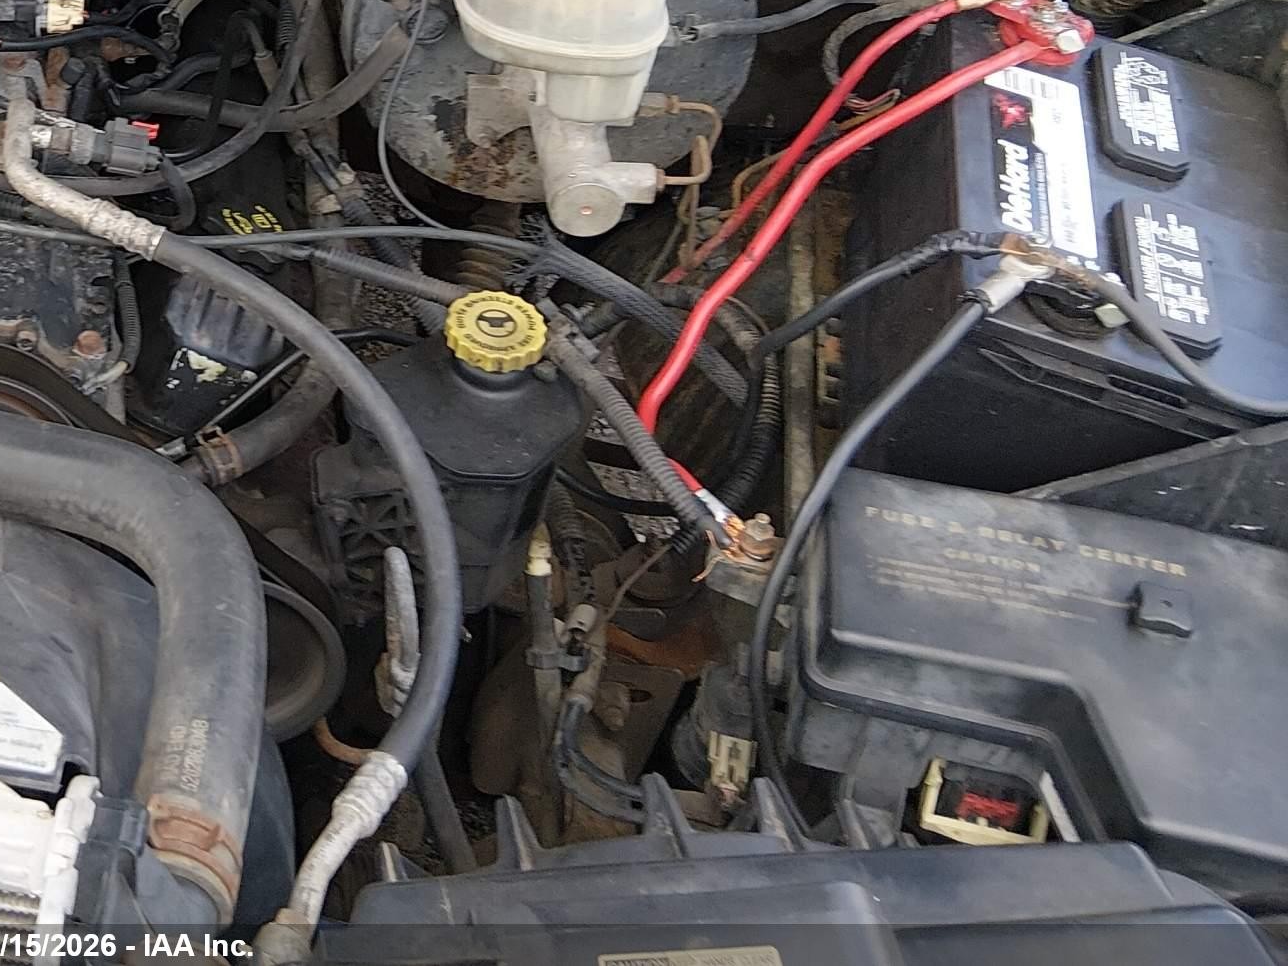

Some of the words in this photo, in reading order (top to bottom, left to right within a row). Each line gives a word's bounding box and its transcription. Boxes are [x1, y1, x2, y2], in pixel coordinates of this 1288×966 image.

[997, 139, 1034, 233] DieHard
[864, 506, 937, 529] FUSE
[977, 525, 1065, 552] RELAY
[1078, 543, 1188, 578] CENTER
[942, 547, 1041, 574] CAUTION
